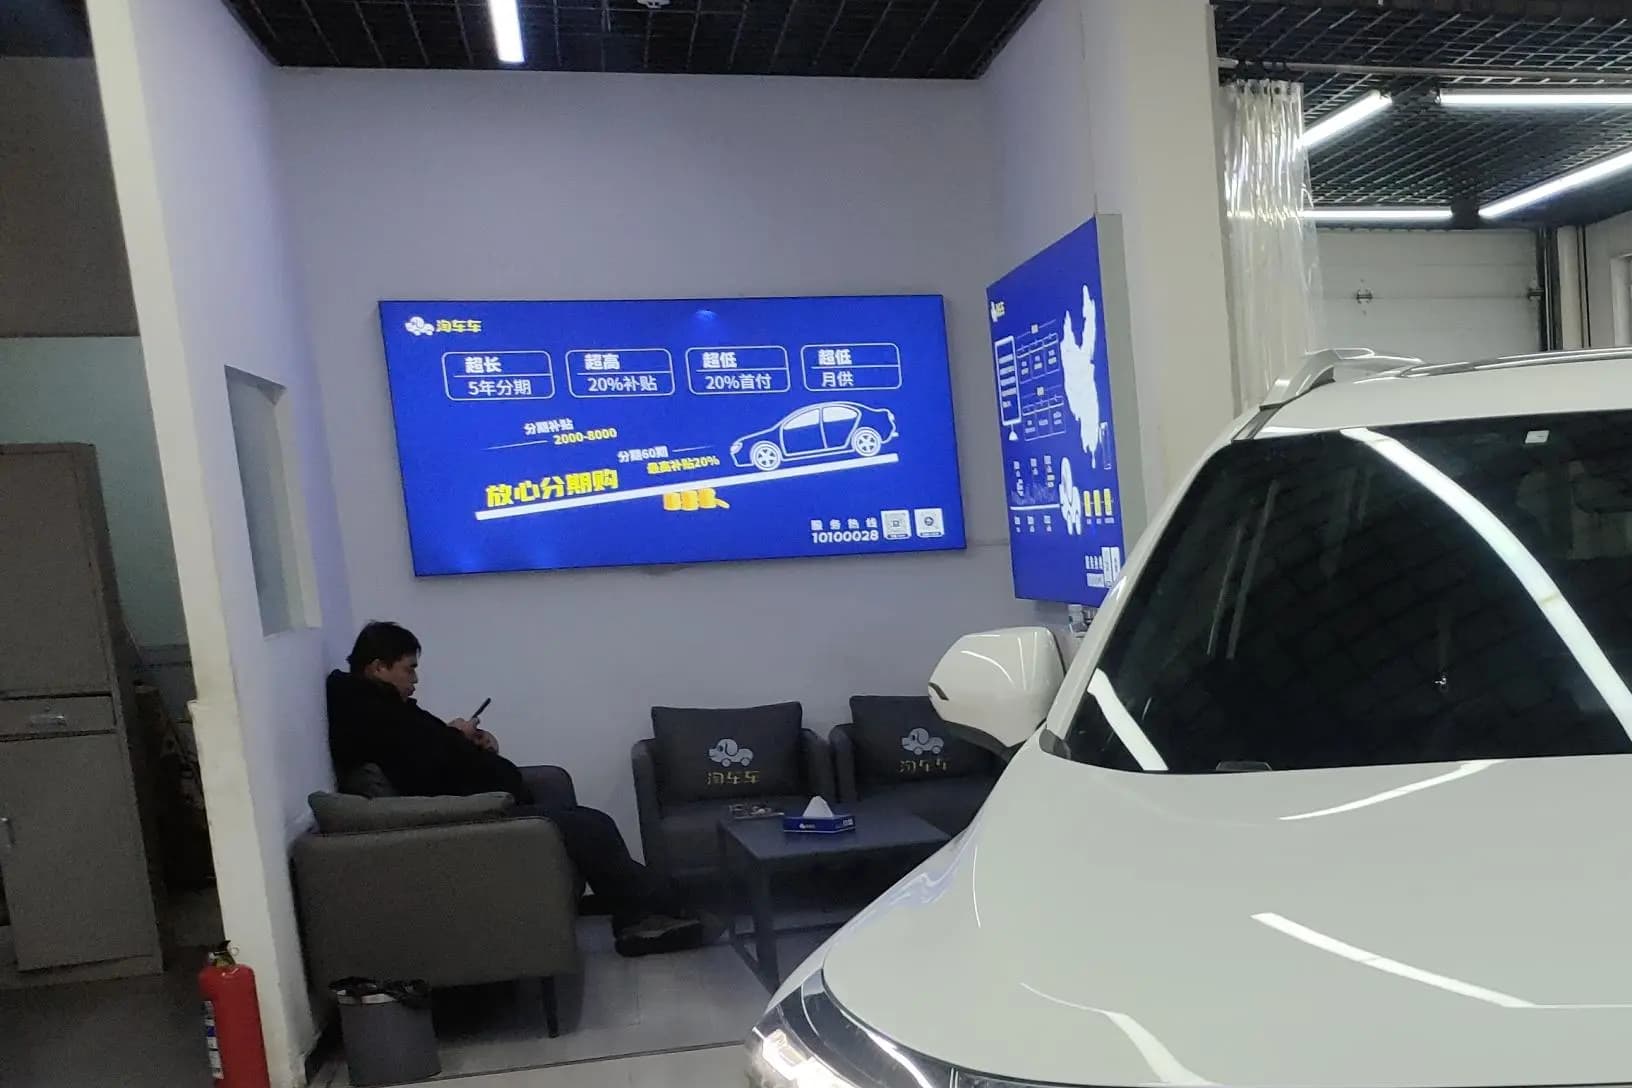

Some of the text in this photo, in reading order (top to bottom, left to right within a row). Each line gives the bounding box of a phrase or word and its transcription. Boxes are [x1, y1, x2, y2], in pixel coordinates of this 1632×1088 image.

[436, 319, 482, 333] 淘车车
[465, 356, 502, 374] 超长
[584, 353, 620, 371] 超高
[702, 351, 738, 368] 超低
[818, 349, 852, 365] 超低
[468, 379, 532, 396] 5年分期
[587, 375, 658, 392] 20%补贴
[705, 373, 772, 390] 20%首付
[822, 371, 854, 387] 月供
[523, 418, 574, 435] 分期补贴
[553, 427, 617, 445] 2000-8000
[486, 468, 619, 507] 放心分期购
[812, 530, 879, 543] 10100028
